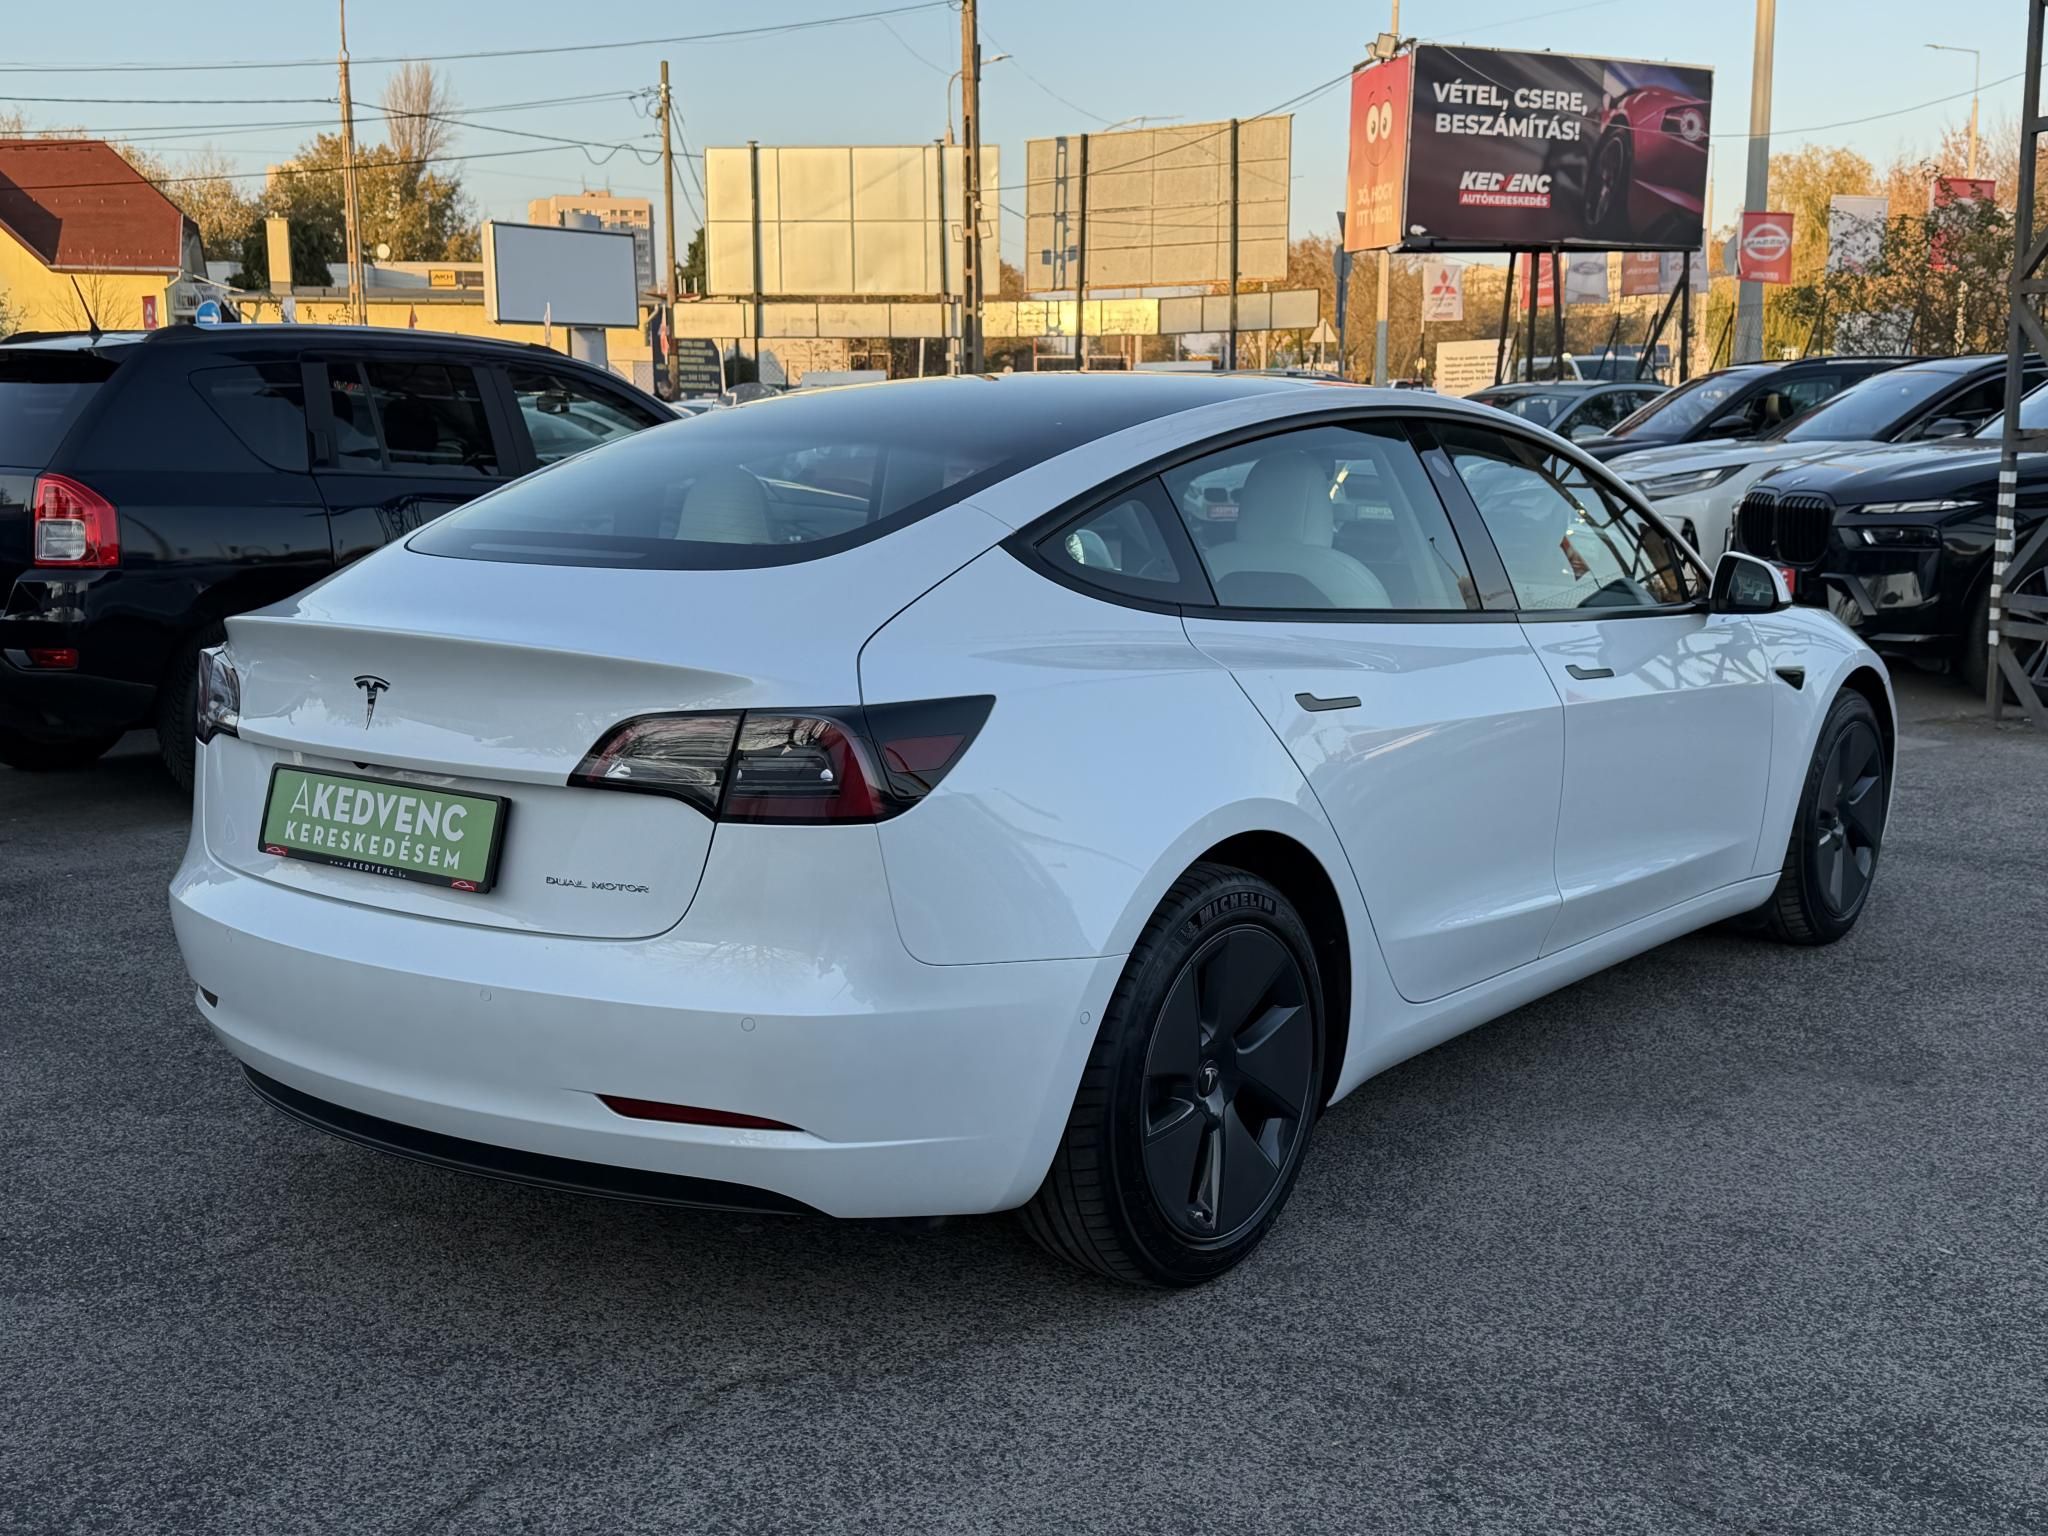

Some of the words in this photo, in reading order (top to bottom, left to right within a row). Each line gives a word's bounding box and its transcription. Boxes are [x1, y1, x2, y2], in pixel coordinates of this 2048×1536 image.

[1432, 78, 1509, 110] VÉTEL,
[1513, 87, 1588, 116] CSERE,
[1435, 111, 1581, 141] BESZÁMÍTÁS!
[1461, 193, 1548, 207] AUTÓKERESKEDÉS
[284, 820, 461, 871] KERESKEDÉSEM
[546, 876, 588, 889] DUAL
[591, 881, 649, 894] MOTOR
[1199, 892, 1274, 924] MICHELIN
